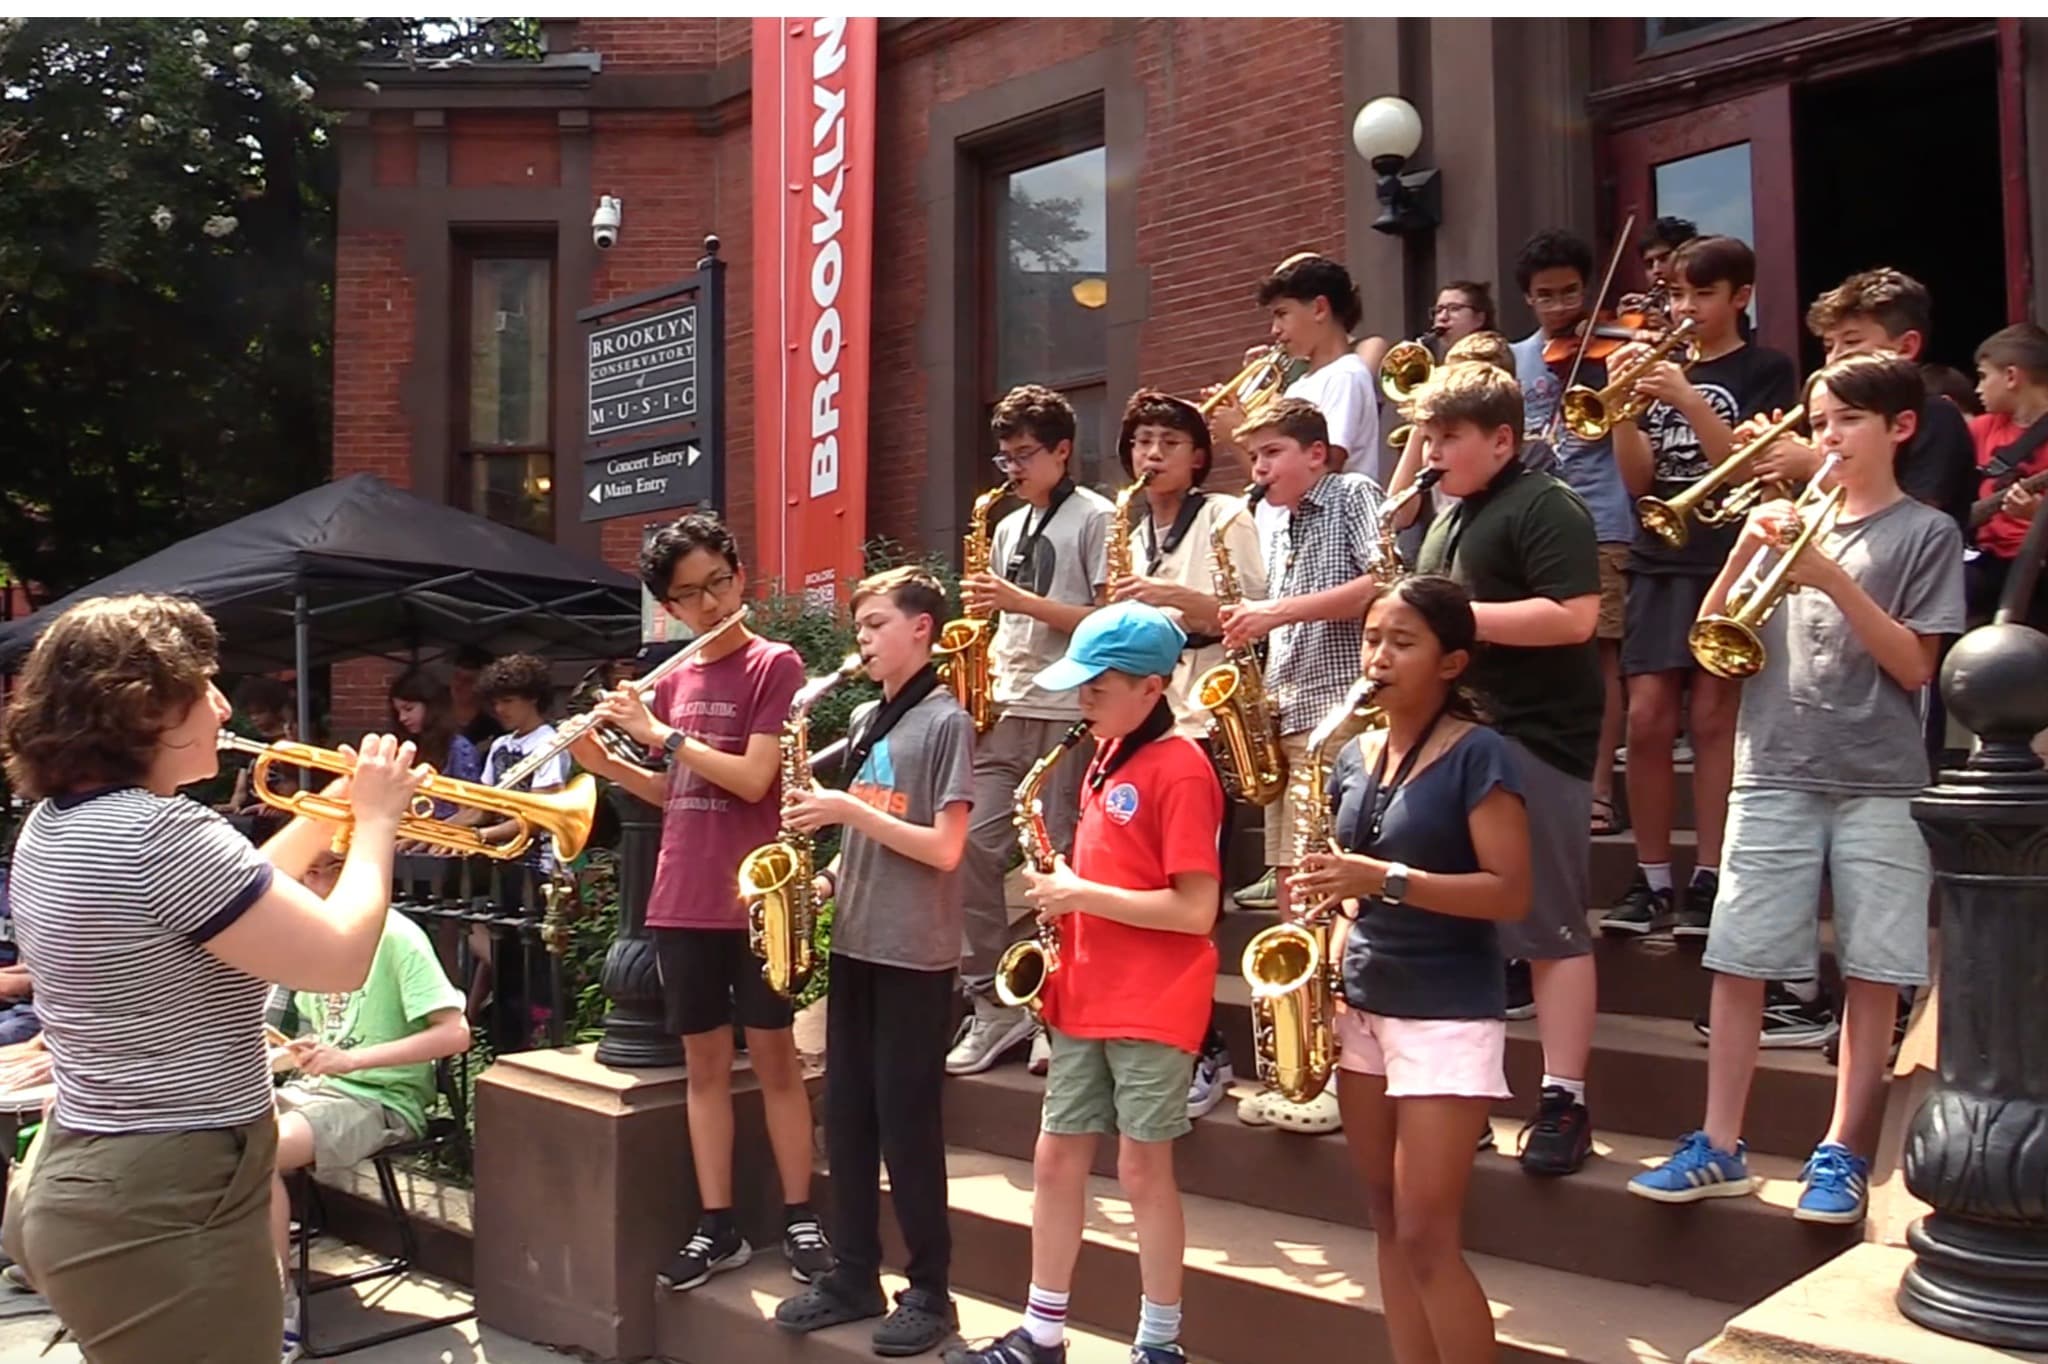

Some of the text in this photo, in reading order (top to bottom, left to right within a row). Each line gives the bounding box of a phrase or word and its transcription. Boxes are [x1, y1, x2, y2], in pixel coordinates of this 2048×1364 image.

[810, 17, 847, 498] BROOKLYN
[592, 315, 694, 358] BROOKLYN
[591, 344, 694, 379] CONSERVATORY
[607, 450, 685, 475] Concert Entry
[604, 477, 669, 499] Main Entry
